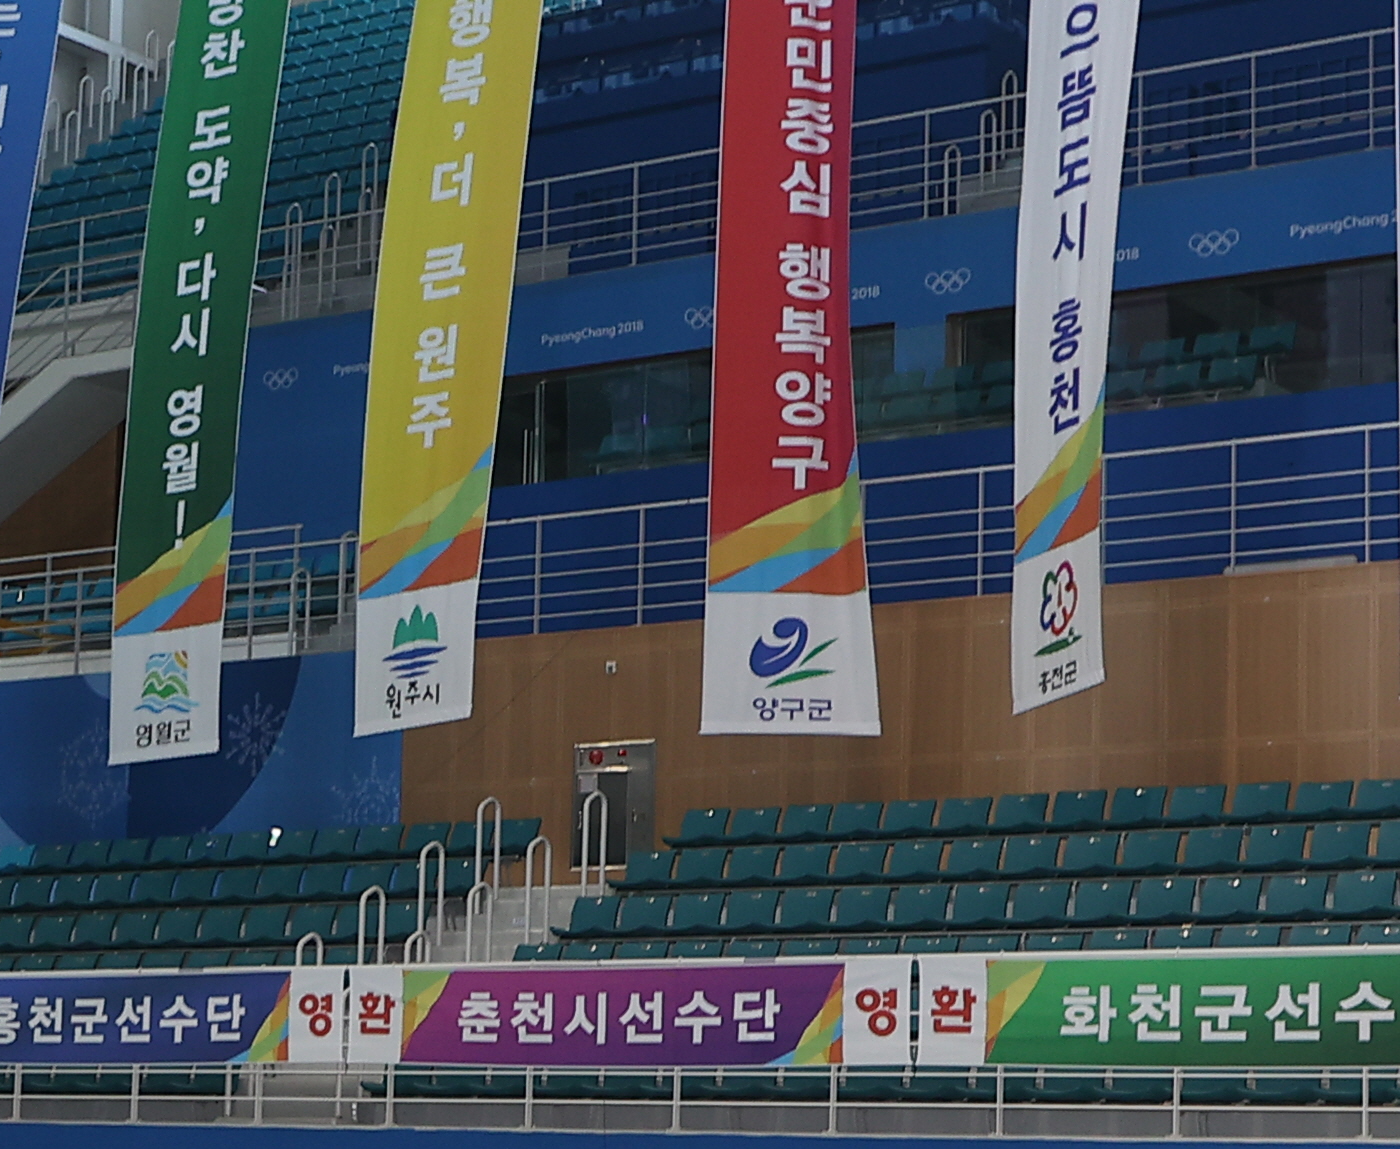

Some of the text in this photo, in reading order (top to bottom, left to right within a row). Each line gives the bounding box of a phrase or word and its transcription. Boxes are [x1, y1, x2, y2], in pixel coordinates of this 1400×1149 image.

[186, 105, 232, 236] 도약,
[430, 152, 474, 207] 더
[1048, 2, 1100, 436] 으뜸도시 홍천
[1290, 213, 1389, 239] PyeongChang
[419, 242, 467, 301] 큰
[1114, 247, 1140, 262] 018
[170, 252, 217, 357] 다시
[851, 285, 880, 300] 2018
[541, 319, 644, 347] PyeongChang 2018
[406, 323, 458, 449] 원주
[771, 242, 832, 490] 행복양구
[162, 384, 203, 550] 영월!
[385, 680, 440, 719] 원주시
[1038, 660, 1077, 694] 홍천군
[136, 719, 190, 748] 영월군
[752, 697, 832, 721] 양구군
[298, 992, 333, 1037] 영
[358, 988, 898, 1045] 환 춘천시선수단 영
[930, 981, 1396, 1043] 환 화천군선수
